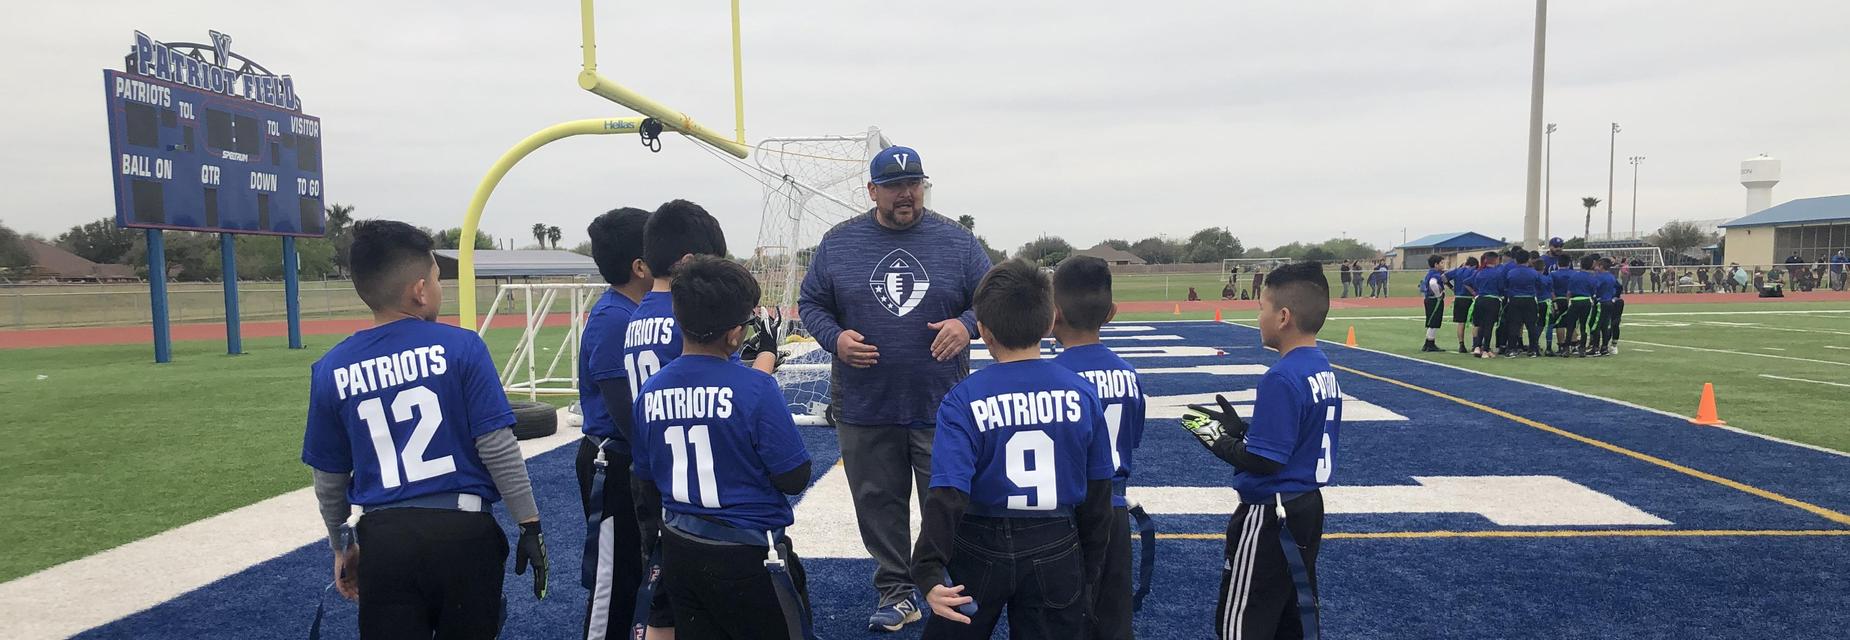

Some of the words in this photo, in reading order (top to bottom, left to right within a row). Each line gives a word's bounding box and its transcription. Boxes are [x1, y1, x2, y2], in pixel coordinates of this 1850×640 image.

[209, 29, 232, 67] V
[134, 29, 236, 97] PATRIOT
[241, 74, 297, 111] FIELD
[115, 76, 171, 108] PATRIOTS
[178, 101, 195, 120] TOL
[290, 115, 319, 138] VISITOR
[604, 120, 635, 130] Hellas
[267, 119, 280, 137] TOL
[122, 153, 152, 175] BALL
[155, 158, 172, 179] ON
[201, 164, 220, 185] QTR
[893, 153, 908, 171] V
[250, 171, 278, 192] DOWN
[297, 177, 308, 196] TO
[309, 179, 320, 197] GO
[624, 317, 675, 349] ATRIOTS
[333, 344, 448, 400] PATRIOTS
[1077, 369, 1139, 400] TRIOTS
[644, 386, 733, 423] PATRIOTS
[970, 389, 1082, 432] PATRIOTS
[357, 385, 457, 489] 12
[1314, 405, 1336, 483] 5
[663, 424, 722, 508] 11
[1005, 429, 1058, 511] 9
